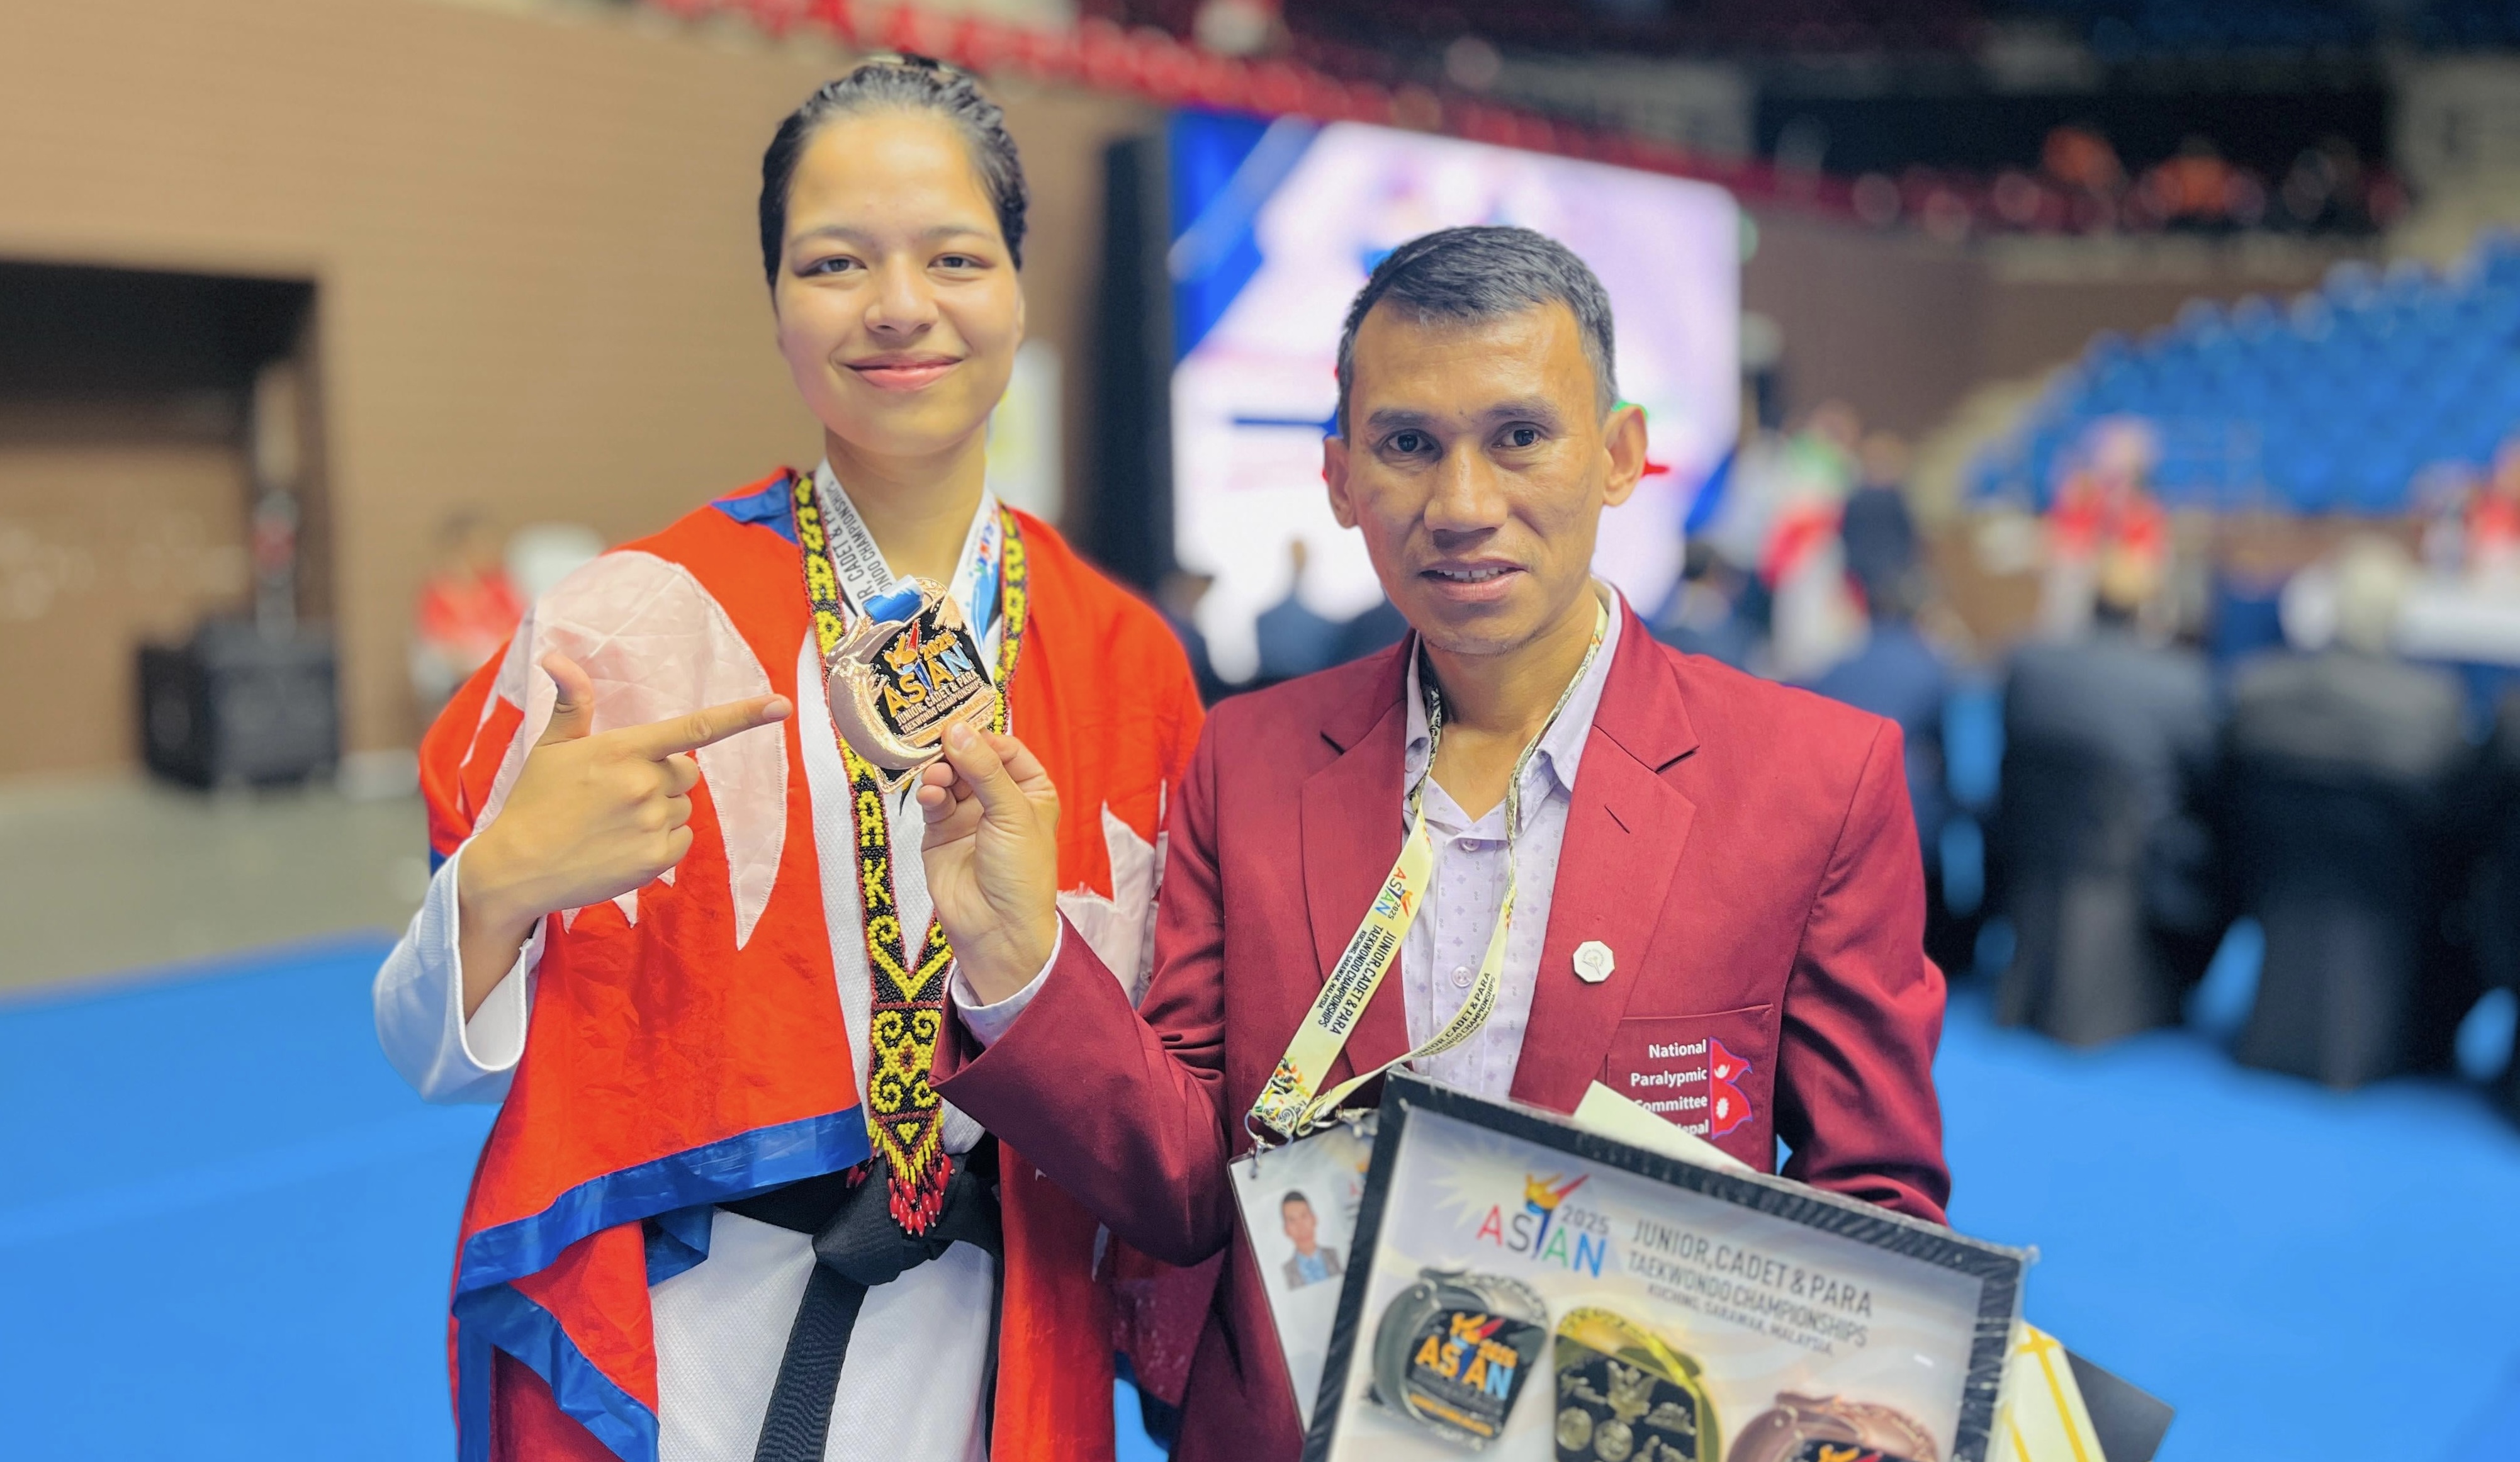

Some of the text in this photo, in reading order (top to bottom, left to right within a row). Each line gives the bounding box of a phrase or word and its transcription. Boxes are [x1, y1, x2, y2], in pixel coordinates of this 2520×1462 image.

[833, 541, 864, 582] CADET
[920, 632, 956, 661] 2025
[884, 643, 972, 717] ASIAN
[925, 687, 950, 707] CADET
[949, 682, 959, 692] &
[955, 670, 980, 687] PARA
[901, 707, 938, 734] TAEKWONDO
[937, 678, 985, 712] CHAMPIONSHIPS
[1375, 867, 1407, 916] ASIAN
[1387, 901, 1401, 921] 2025
[1318, 925, 1383, 1028] TAEKWONDO CHAMPIONSHIPS
[1350, 970, 1376, 1003] CADET
[1473, 972, 1490, 1001] PARA
[1346, 999, 1358, 1009] &
[1461, 976, 1495, 1033] CHAMPIONSHIPS
[1470, 1001, 1478, 1009] &
[1329, 1007, 1353, 1035] PARA
[1446, 1008, 1472, 1038] CADET
[1649, 1039, 1707, 1058] National
[1631, 1067, 1707, 1088] Paralypmic
[1675, 1119, 1709, 1135] epal
[1561, 1205, 1611, 1234] 2025
[1477, 1204, 1606, 1278] ASIAN
[1714, 1244, 1787, 1288] CADET
[1789, 1268, 1804, 1296] &
[1808, 1274, 1872, 1318] PARA
[1628, 1250, 1869, 1349] TAEKWONDO CHAMPIONSHIPS
[1415, 1334, 1515, 1400] ASIAN
